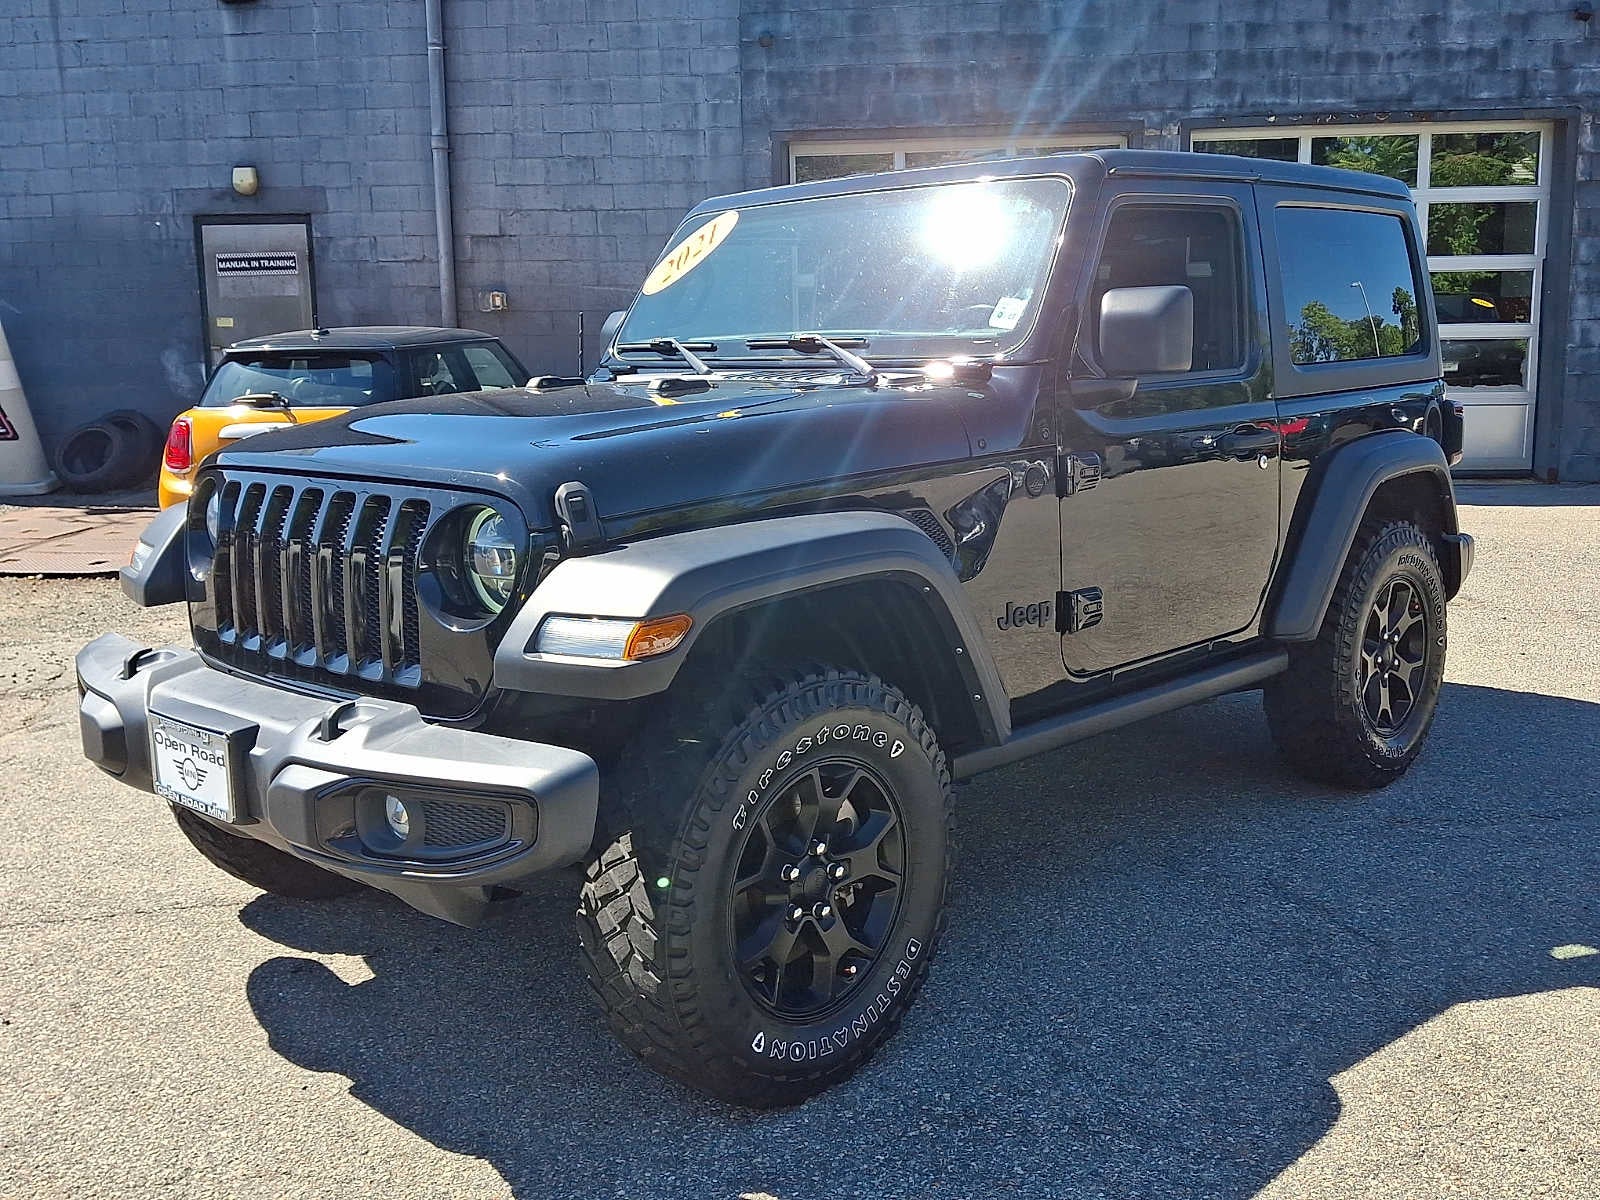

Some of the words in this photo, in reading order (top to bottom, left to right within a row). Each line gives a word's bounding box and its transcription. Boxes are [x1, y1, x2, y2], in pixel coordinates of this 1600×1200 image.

[218, 260, 250, 269] MANUAL
[260, 259, 296, 268] TRAINING
[662, 224, 717, 284] 2021
[997, 600, 1051, 631] Jeep
[154, 731, 187, 753] Open
[191, 744, 225, 766] Road
[181, 796, 206, 811] ROAD
[207, 805, 227, 820] MINI
[770, 937, 922, 1062] DESTINATION
